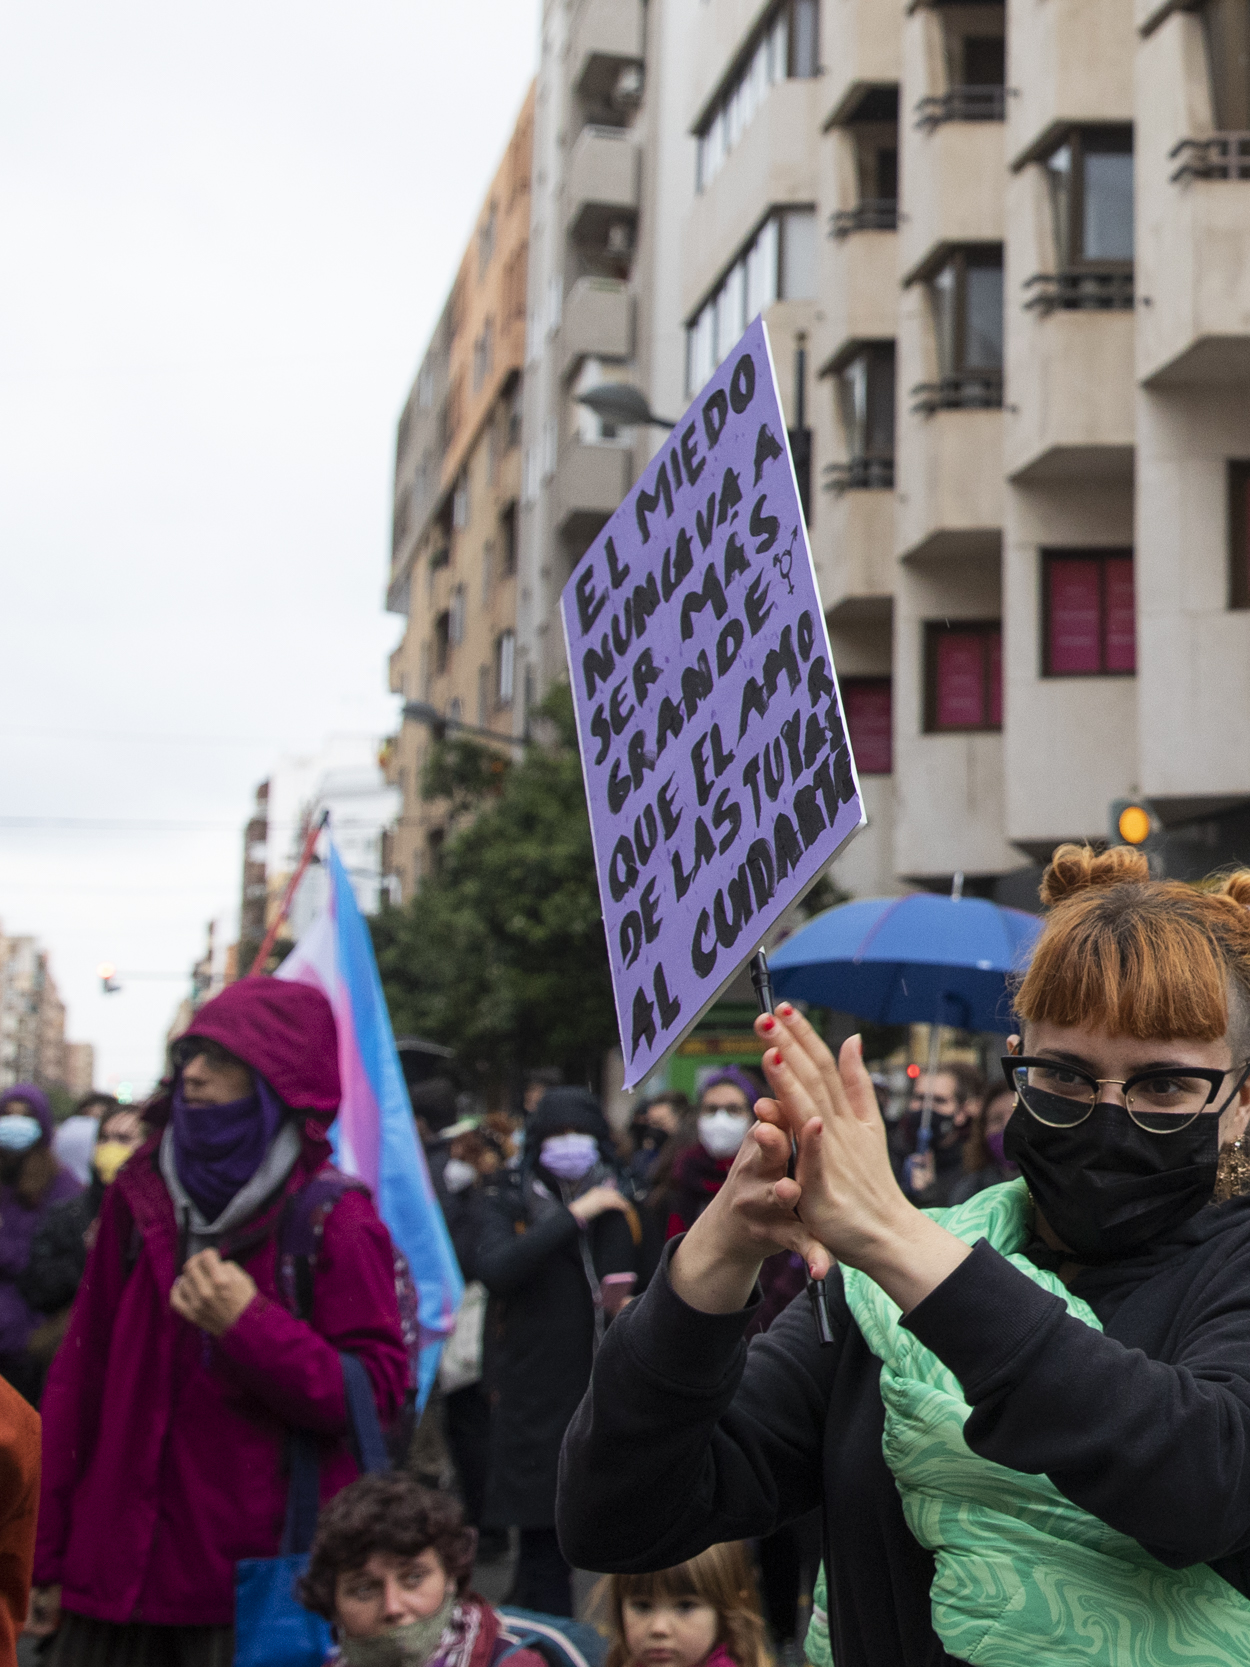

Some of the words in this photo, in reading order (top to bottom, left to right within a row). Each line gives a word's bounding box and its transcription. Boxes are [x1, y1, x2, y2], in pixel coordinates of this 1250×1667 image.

[576, 537, 629, 634] EL
[636, 354, 755, 543] MIEDO
[583, 528, 693, 700] NUNCA
[697, 468, 742, 550] VA
[754, 424, 782, 485] A
[591, 648, 662, 765] SER
[608, 572, 773, 814] GRANDE
[609, 777, 682, 902] QUE
[691, 723, 735, 806] EL
[738, 611, 835, 743] AMOR
[620, 877, 662, 970] DE
[672, 788, 741, 902] LAS
[743, 699, 844, 827] TUYAS
[632, 963, 680, 1064] AL
[692, 742, 855, 978] CUIDARTE
